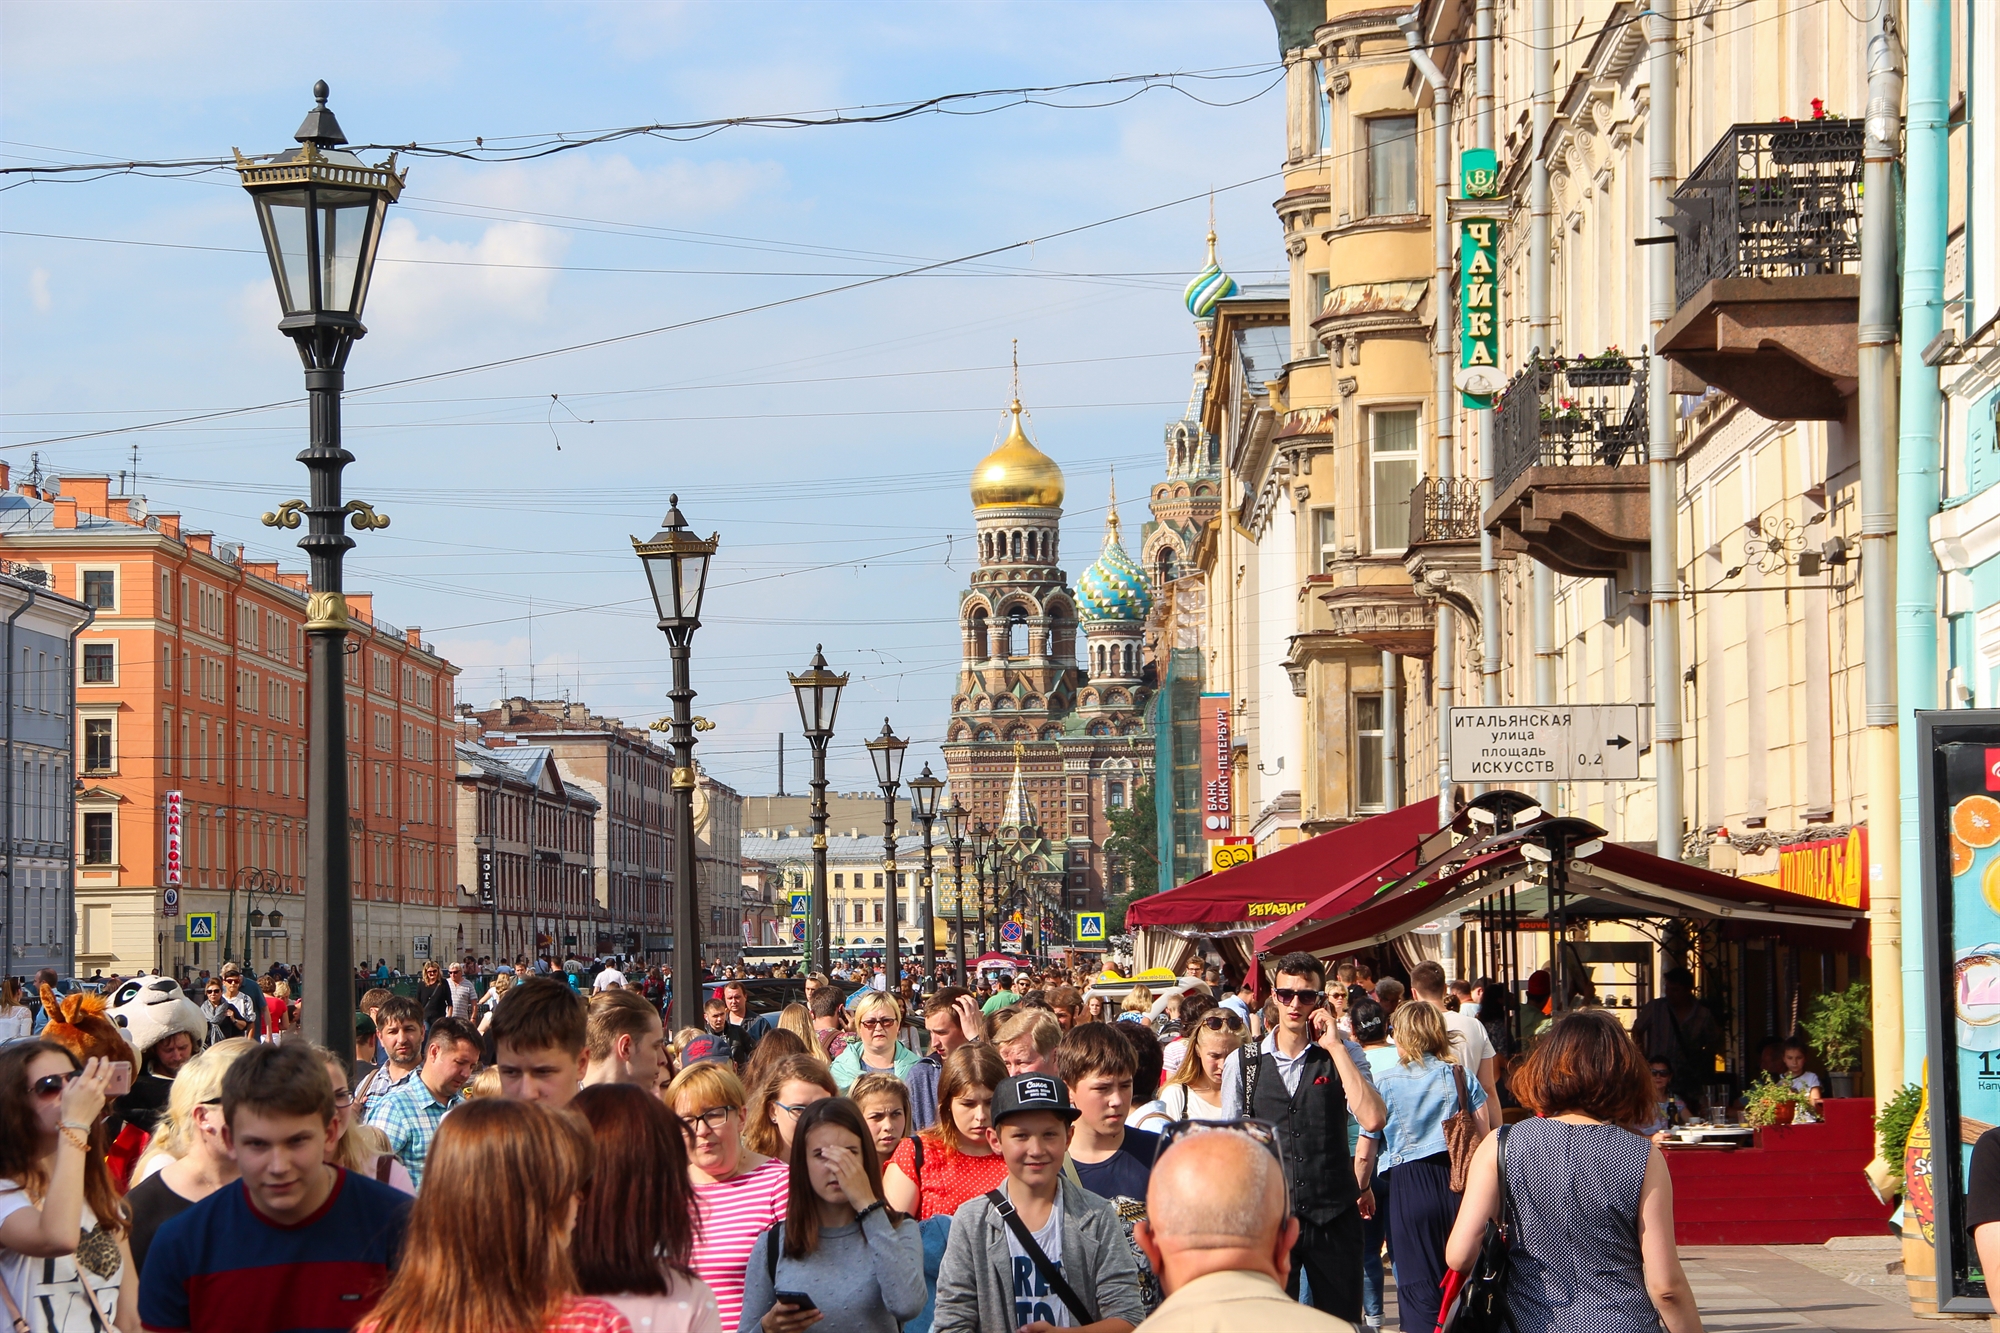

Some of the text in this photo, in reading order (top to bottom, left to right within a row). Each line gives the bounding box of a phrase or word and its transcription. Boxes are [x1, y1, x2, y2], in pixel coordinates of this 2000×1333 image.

[1467, 223, 1493, 364] ЧАЙКА
[1455, 714, 1572, 728] ИТАЛЬЯНСКАЯ
[1491, 731, 1535, 743] улица
[1217, 708, 1229, 811] САНКТ-ПЕТЕРБУРГ
[1481, 746, 1546, 758] площадь
[1578, 754, 1603, 767] 0,2
[1472, 761, 1555, 773] ИСКУССТВ
[1207, 780, 1218, 811] БАНК
[167, 794, 180, 881] MAMA ROMA
[483, 853, 491, 899] HOTEL
